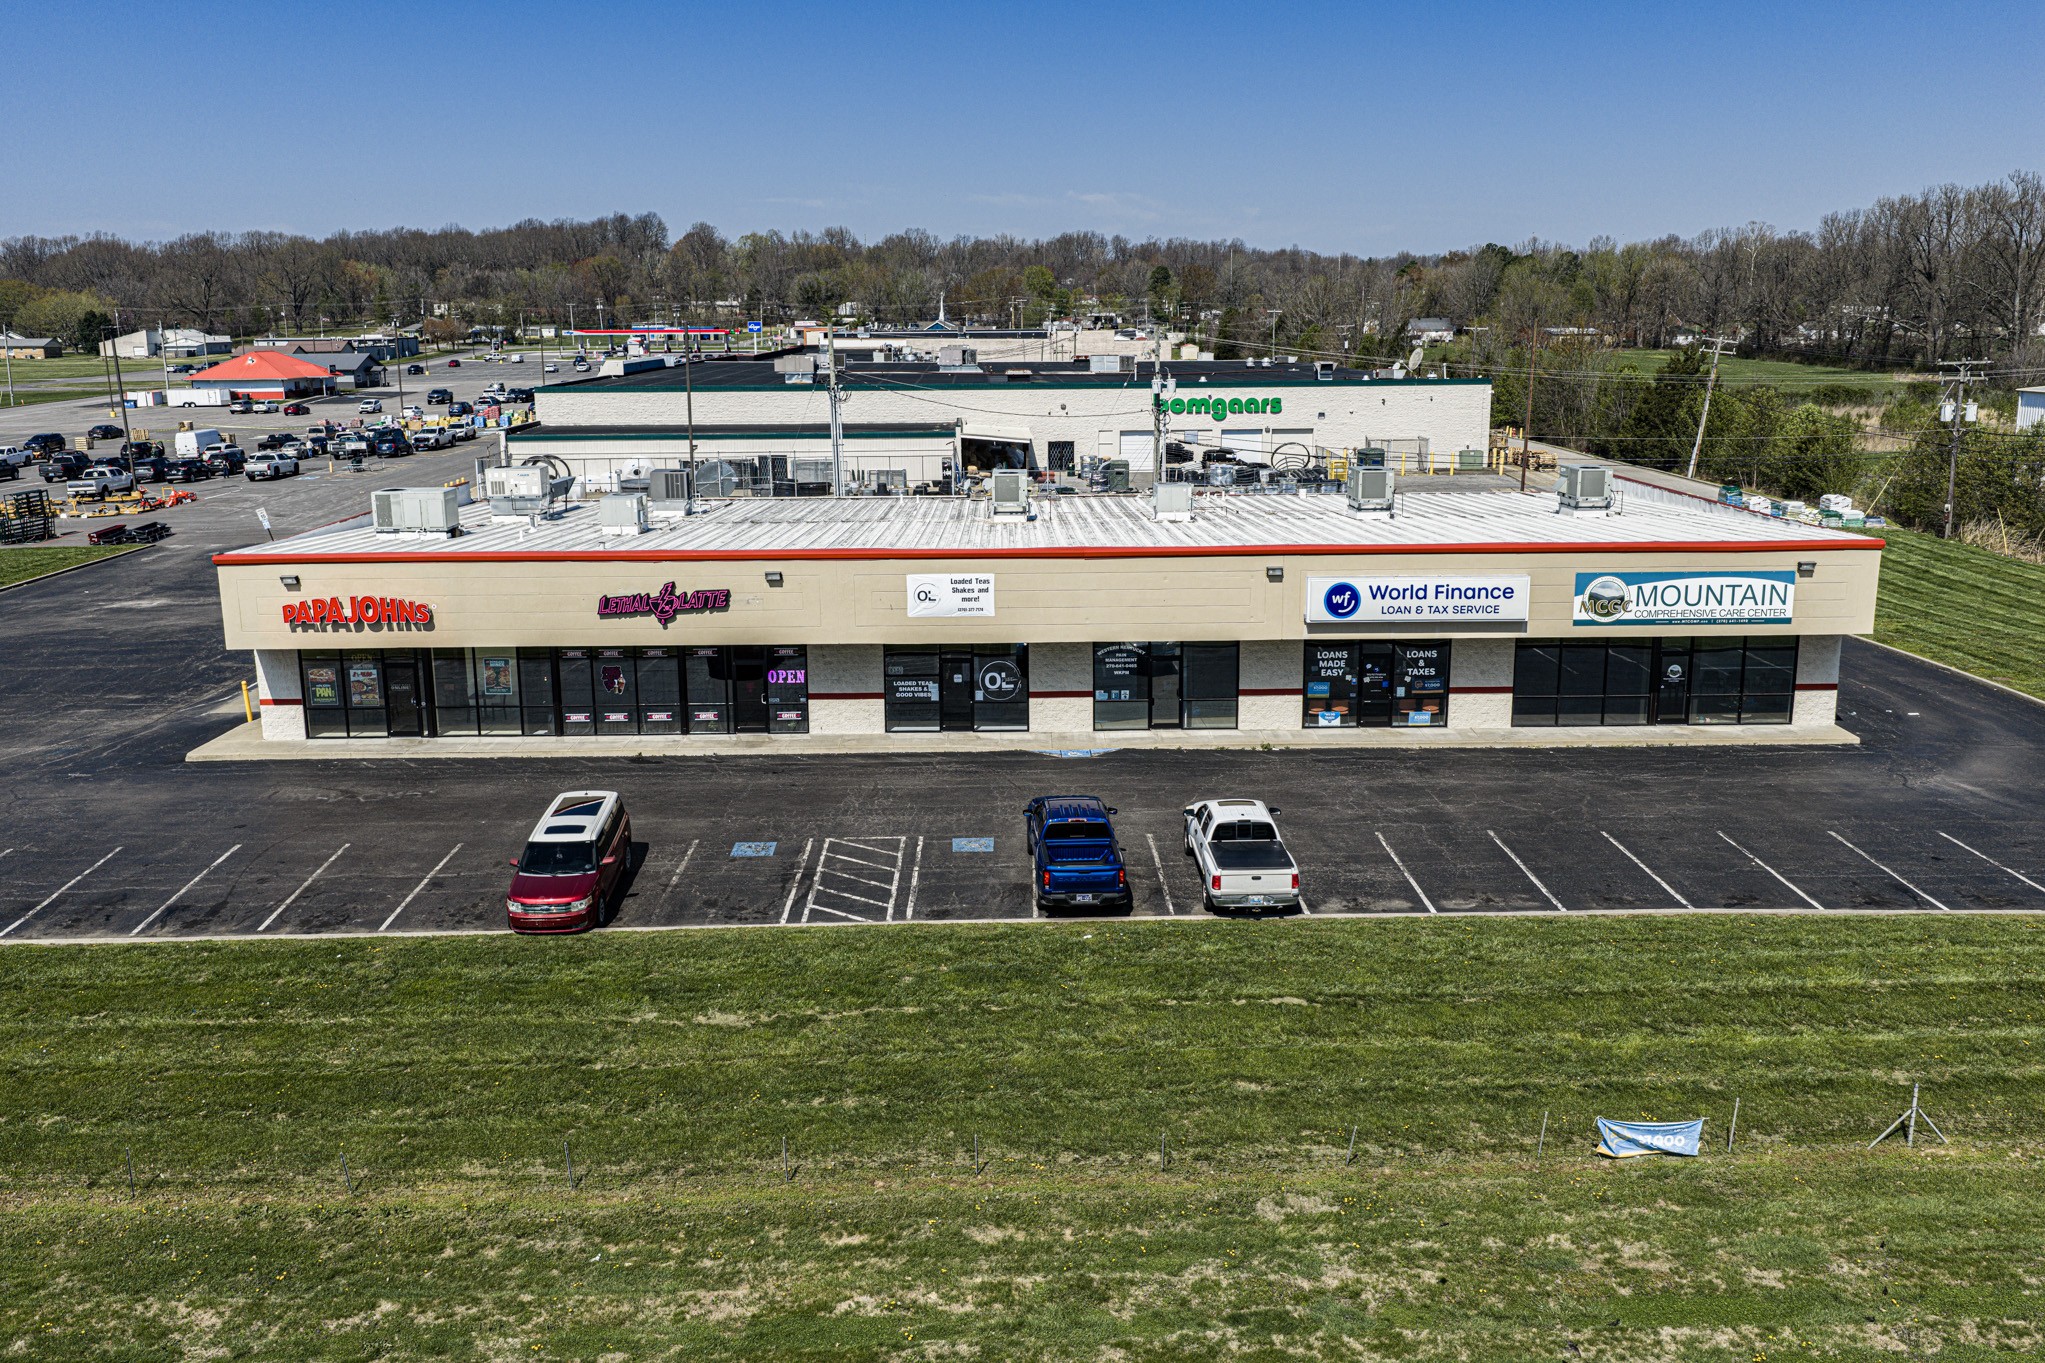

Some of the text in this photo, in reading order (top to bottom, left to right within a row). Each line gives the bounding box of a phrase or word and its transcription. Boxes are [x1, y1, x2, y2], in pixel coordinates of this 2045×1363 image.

[974, 577, 990, 585] Teas
[1368, 584, 1515, 600] World Finance
[1635, 583, 1788, 608] MOUNTAIN
[598, 589, 729, 615] LETHAL LATTE
[961, 595, 980, 603] more!
[1331, 591, 1352, 607] wf
[281, 595, 431, 624] PAPA JOHNS
[1381, 605, 1500, 615] LOAN & TAX SERVICE
[1634, 608, 1787, 619] COMPREHENSIVE CARE CENTER
[1096, 645, 1120, 656] WESTERN
[1317, 651, 1348, 659] LOANS
[1406, 650, 1438, 658] LOANS
[1418, 659, 1425, 667] &
[767, 669, 805, 684] OPEN
[1407, 668, 1436, 676] TAXES
